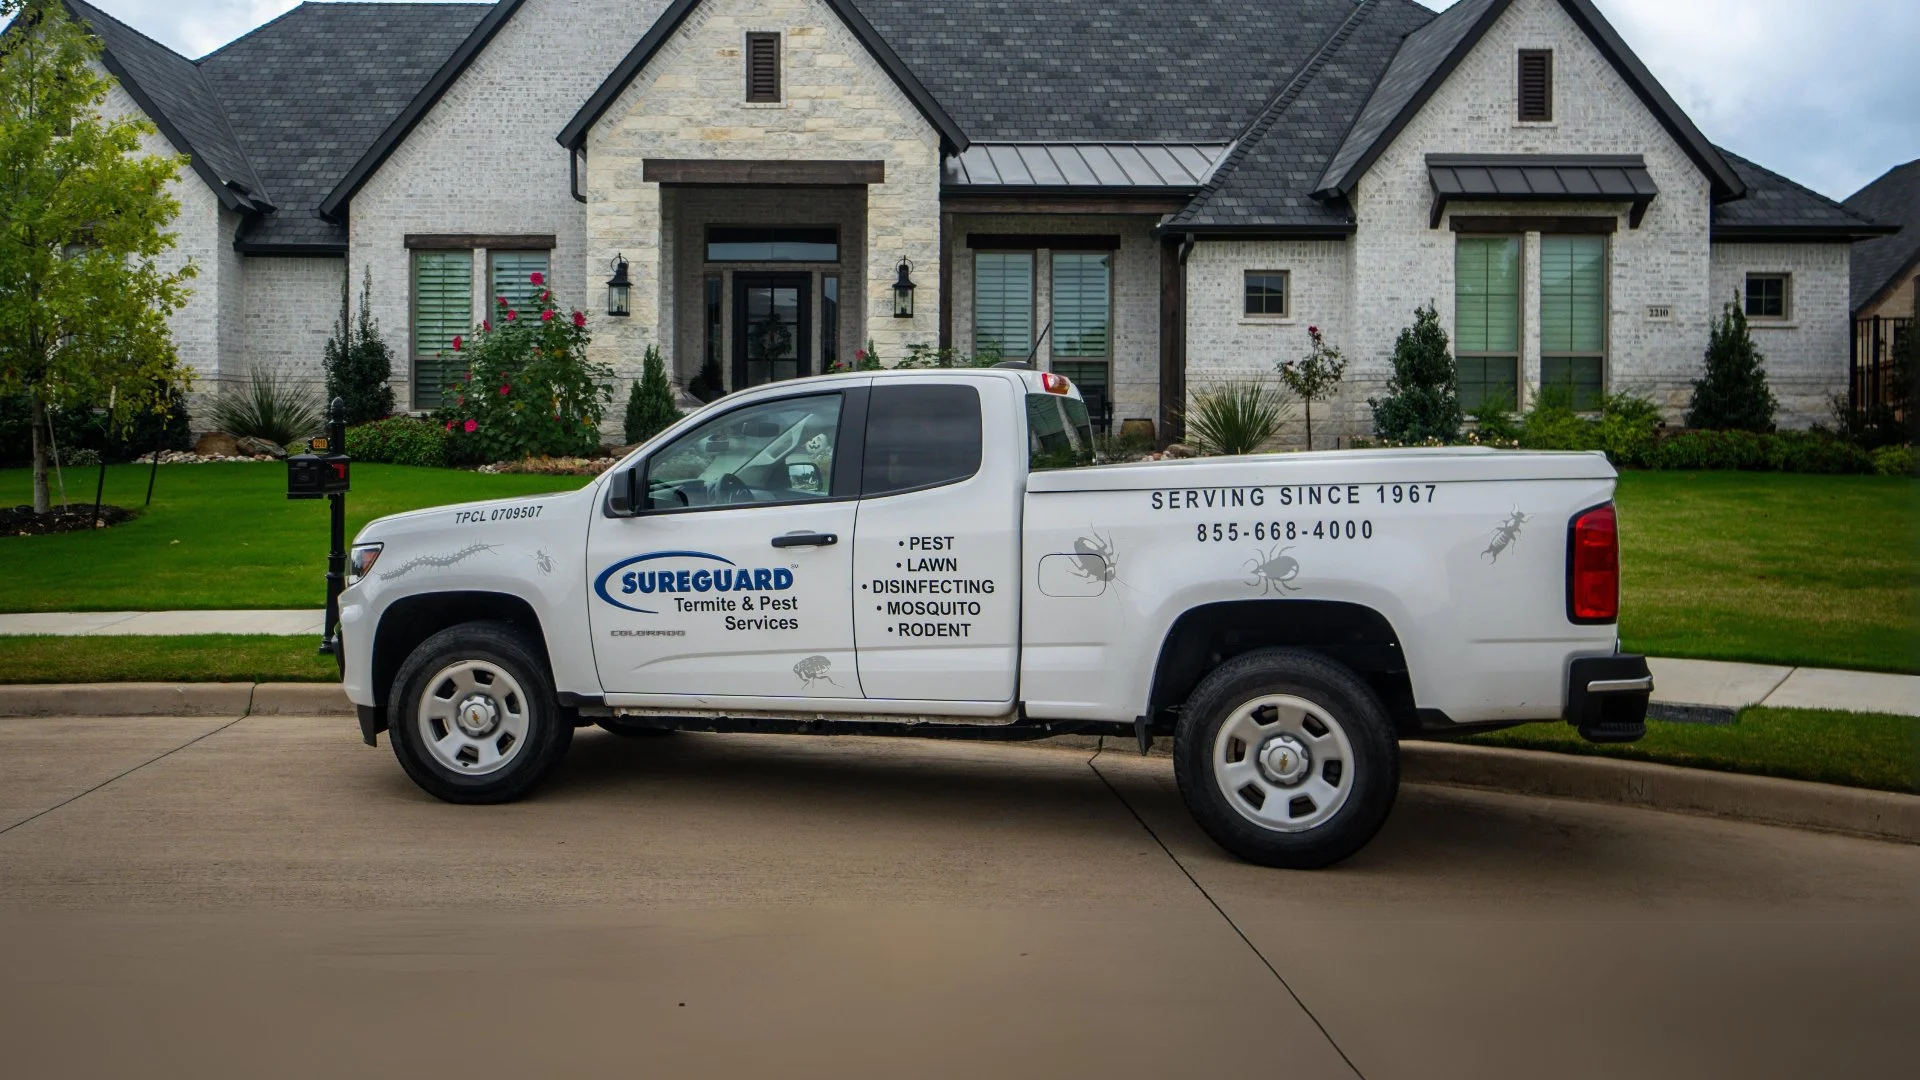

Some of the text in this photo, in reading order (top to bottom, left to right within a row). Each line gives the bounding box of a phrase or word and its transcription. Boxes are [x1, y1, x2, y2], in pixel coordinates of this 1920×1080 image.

[1649, 308, 1668, 317] 2210
[1151, 484, 1437, 510] SERVING SINCE 1967
[455, 505, 543, 524] TPCL 0709507
[1197, 520, 1373, 542] 855-668-4000
[909, 536, 955, 551] PEST
[907, 558, 957, 572] LAWN
[622, 567, 794, 594] SUREGUARD
[872, 579, 995, 594] DISINFECTING
[674, 596, 798, 613] Termite & Pest
[887, 601, 981, 616] MOSQUITO
[725, 615, 799, 630] Services
[898, 623, 972, 637] RODENT
